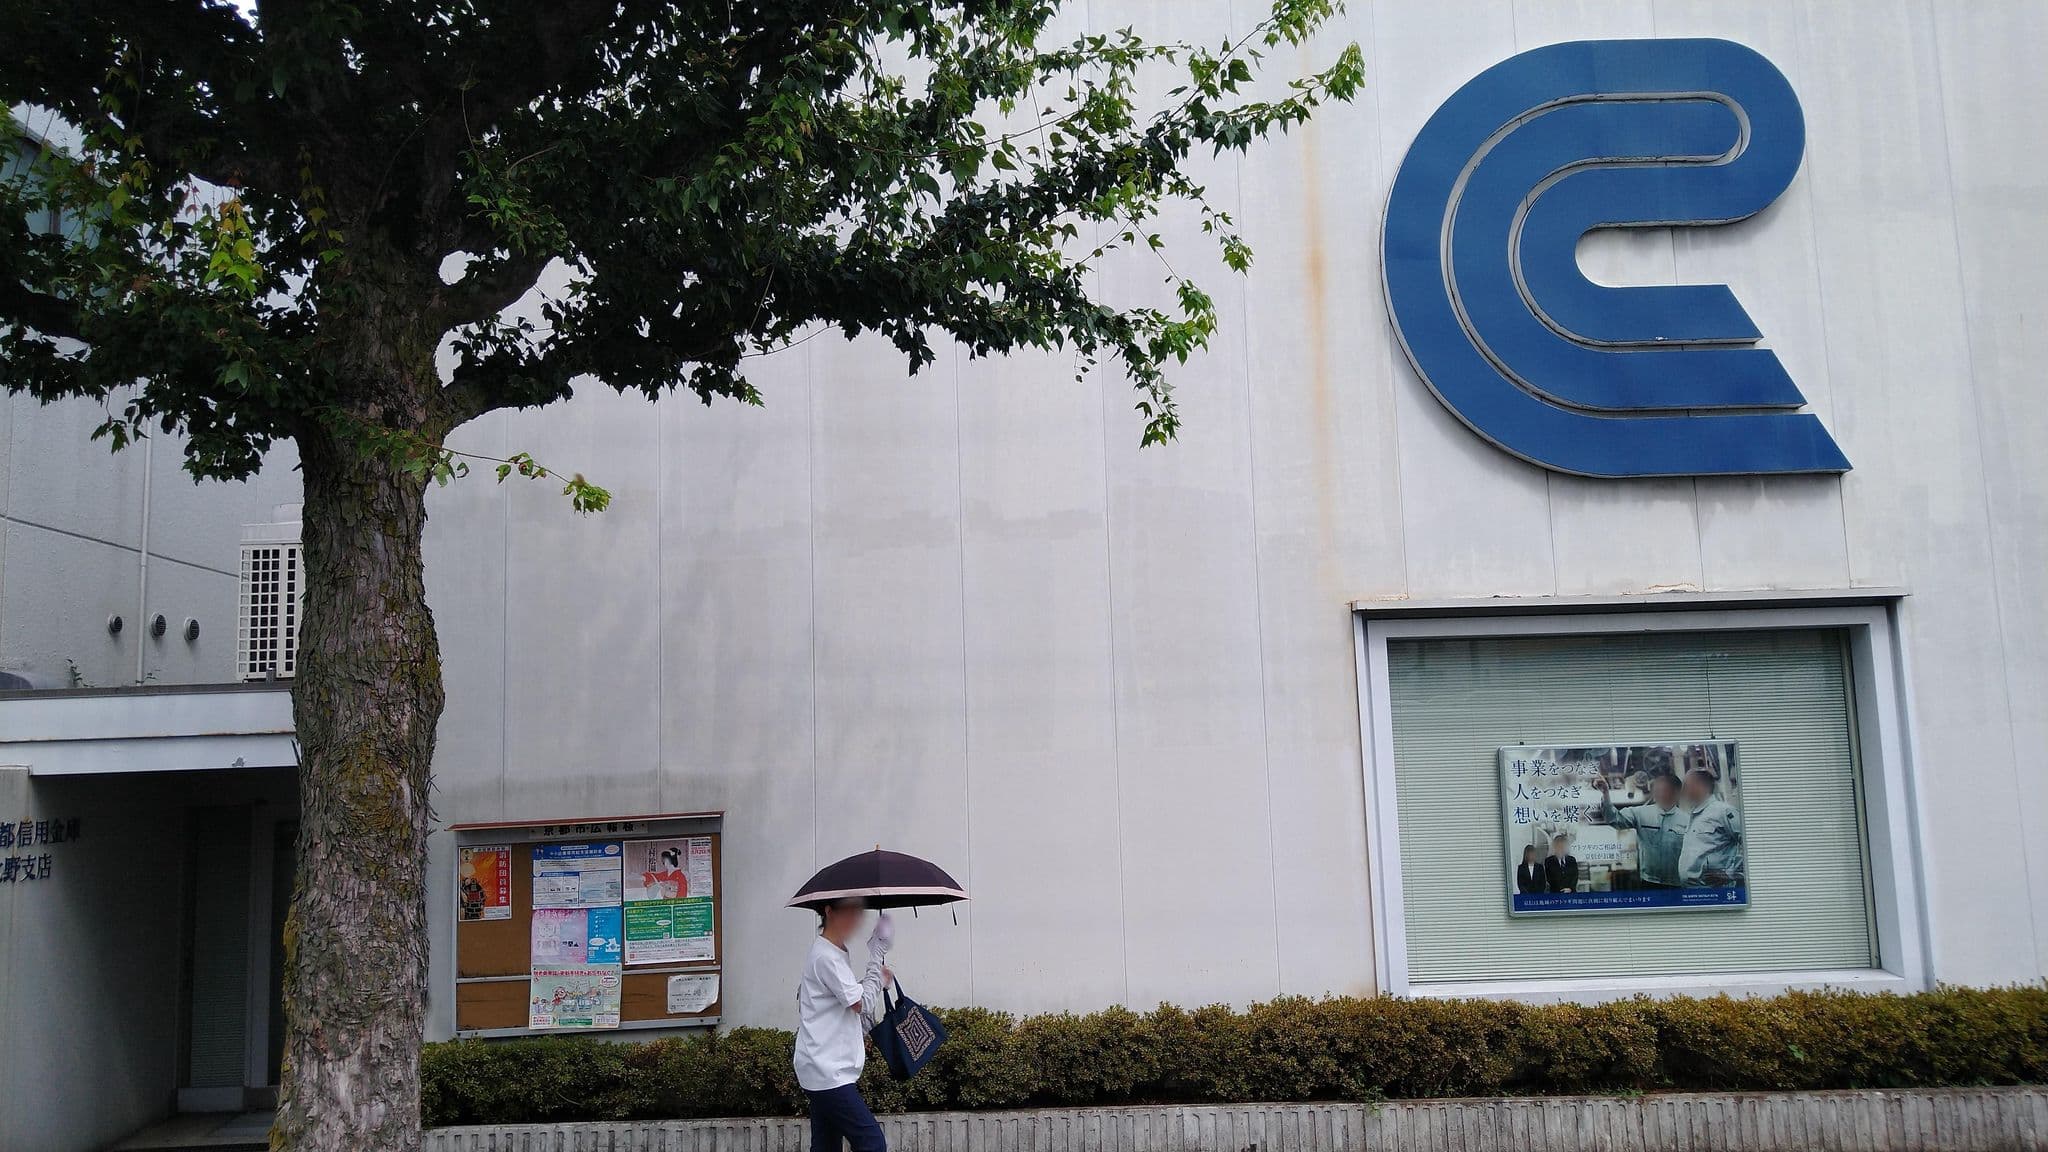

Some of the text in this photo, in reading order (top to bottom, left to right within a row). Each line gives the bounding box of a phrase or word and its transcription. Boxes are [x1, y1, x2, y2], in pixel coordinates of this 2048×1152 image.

[1511, 759, 1600, 777] 事業をつなぎ
[1514, 783, 1582, 800] 人をつなぎ
[1514, 805, 1595, 824] 想いを繋ぐ
